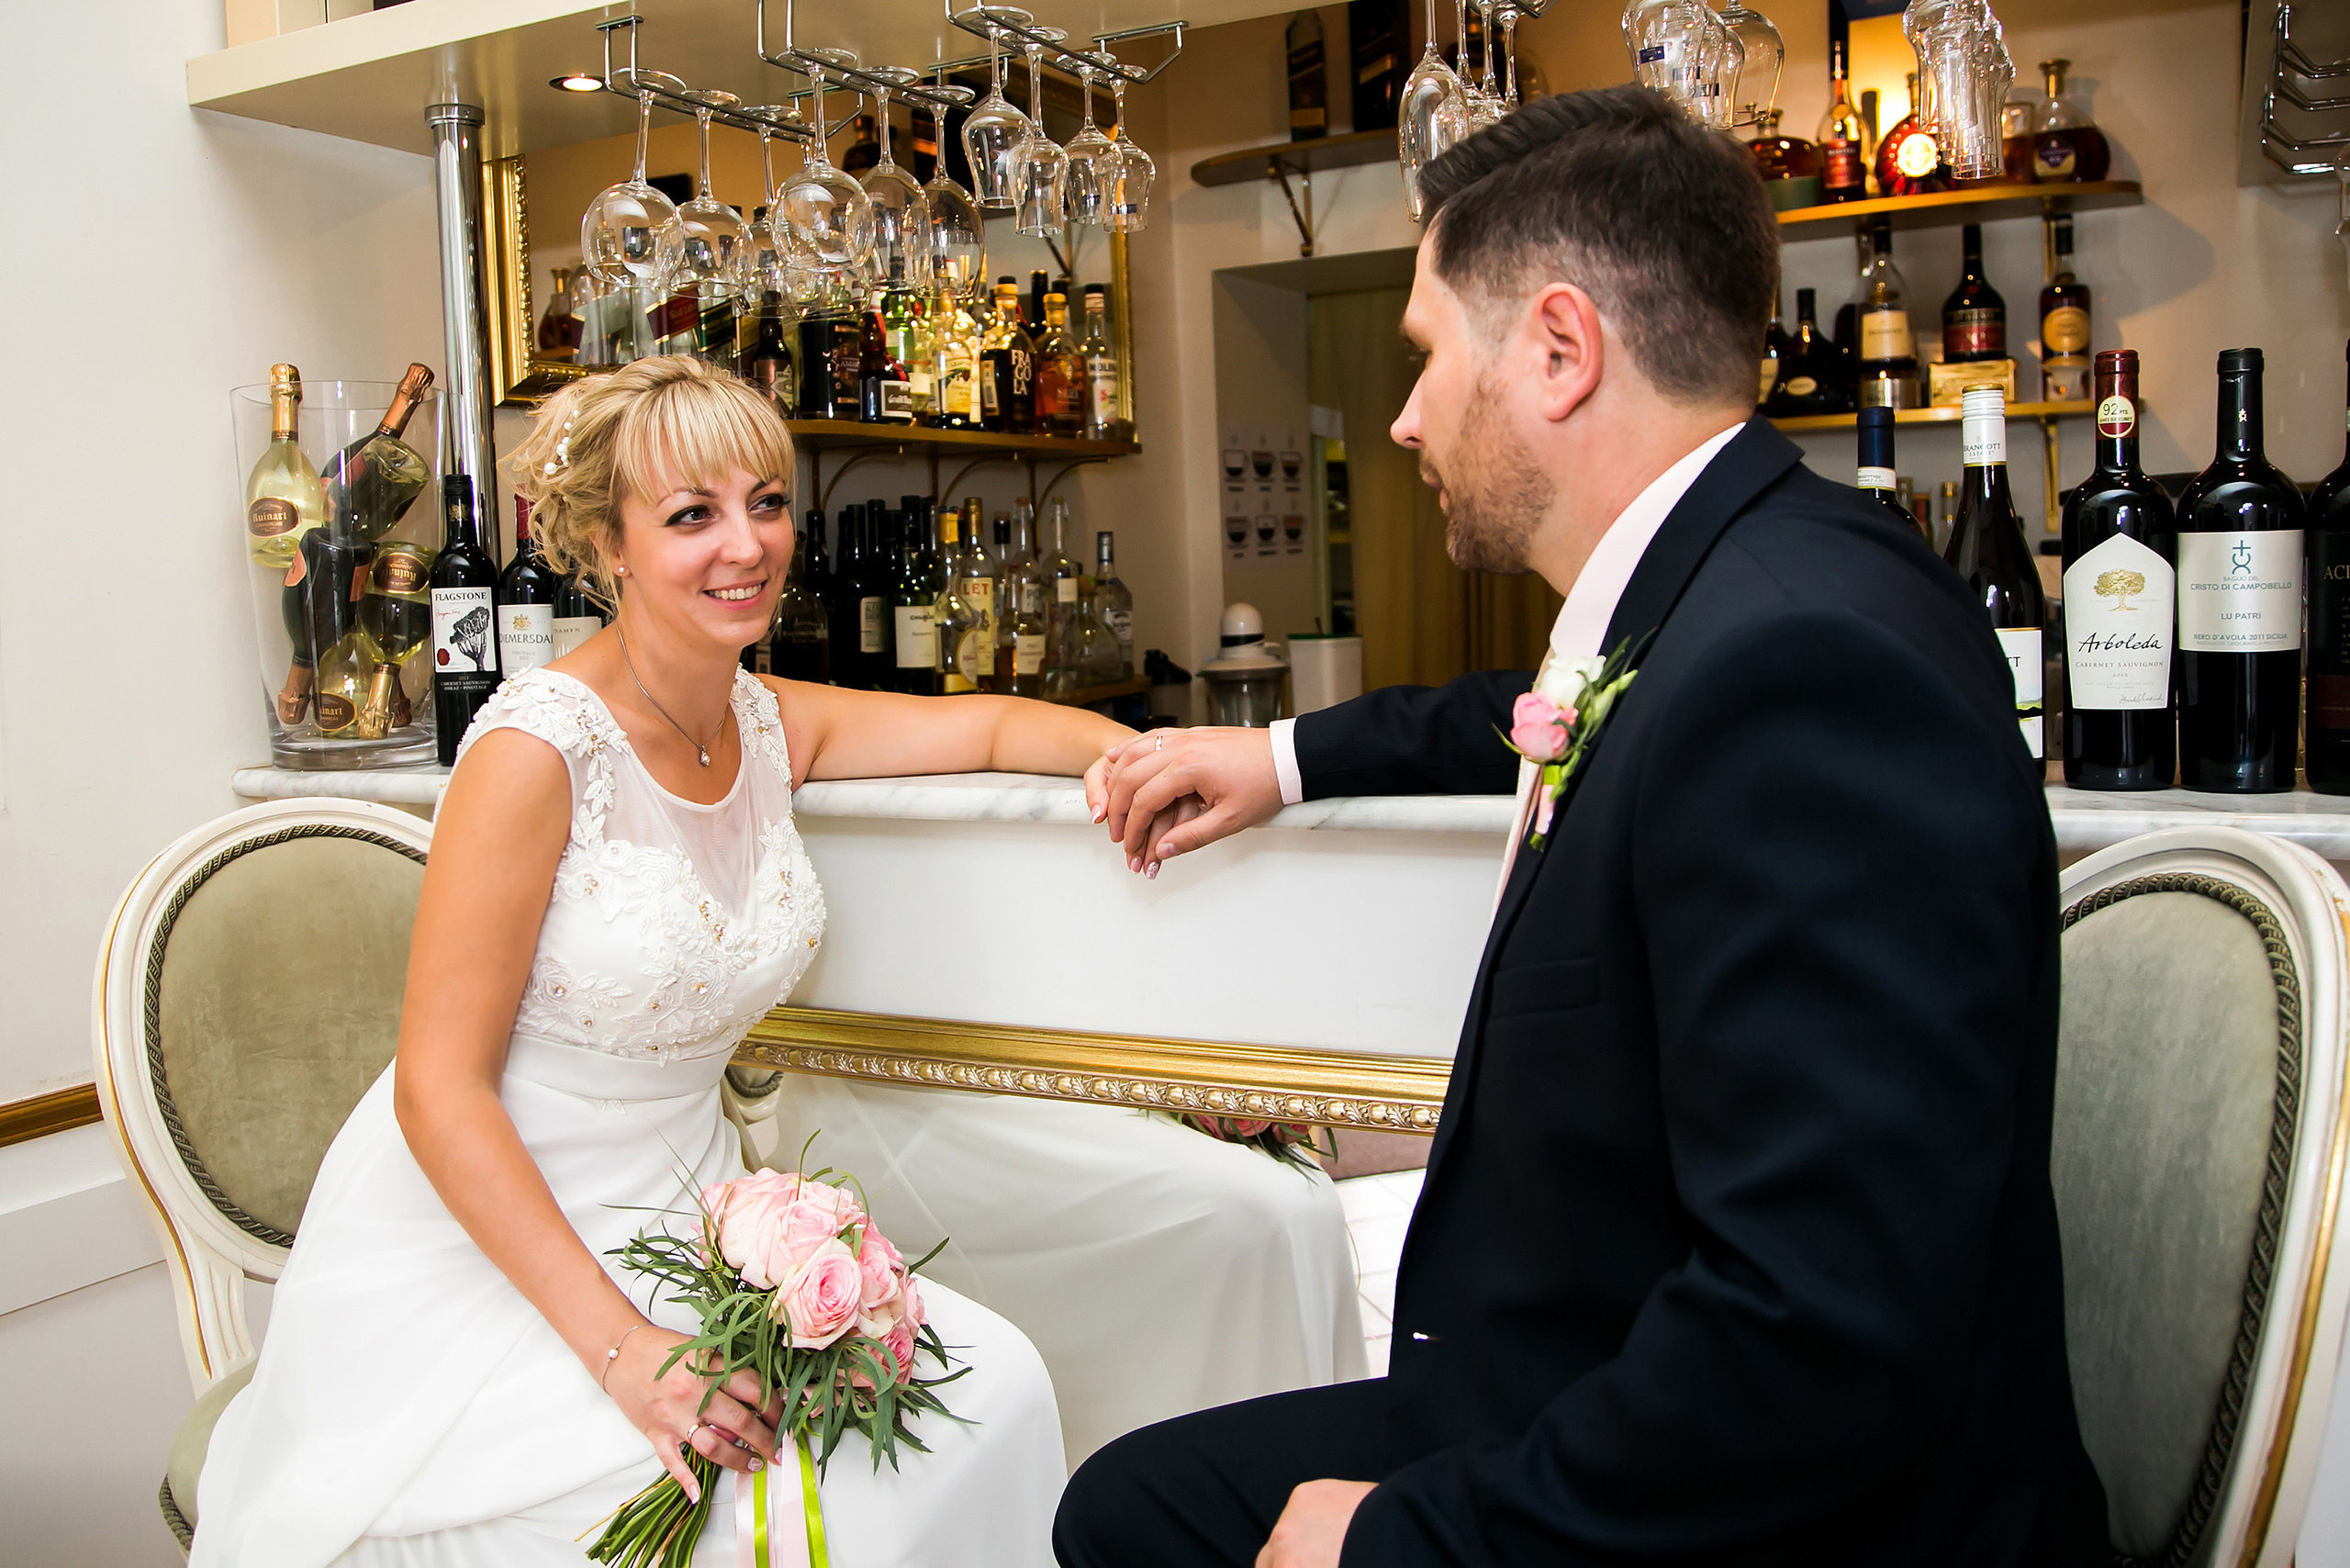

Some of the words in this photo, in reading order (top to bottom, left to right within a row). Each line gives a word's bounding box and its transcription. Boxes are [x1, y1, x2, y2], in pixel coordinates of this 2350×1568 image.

[1012, 349, 1031, 365] FRA
[1015, 365, 1032, 380] GO
[1013, 378, 1027, 395] LA
[2103, 403, 2118, 416] 92
[2232, 582, 2292, 590] CAMPOBELLO
[435, 592, 487, 601] FLAGSTONE
[2078, 633, 2164, 653] Arboleda
[322, 706, 342, 715] inart
